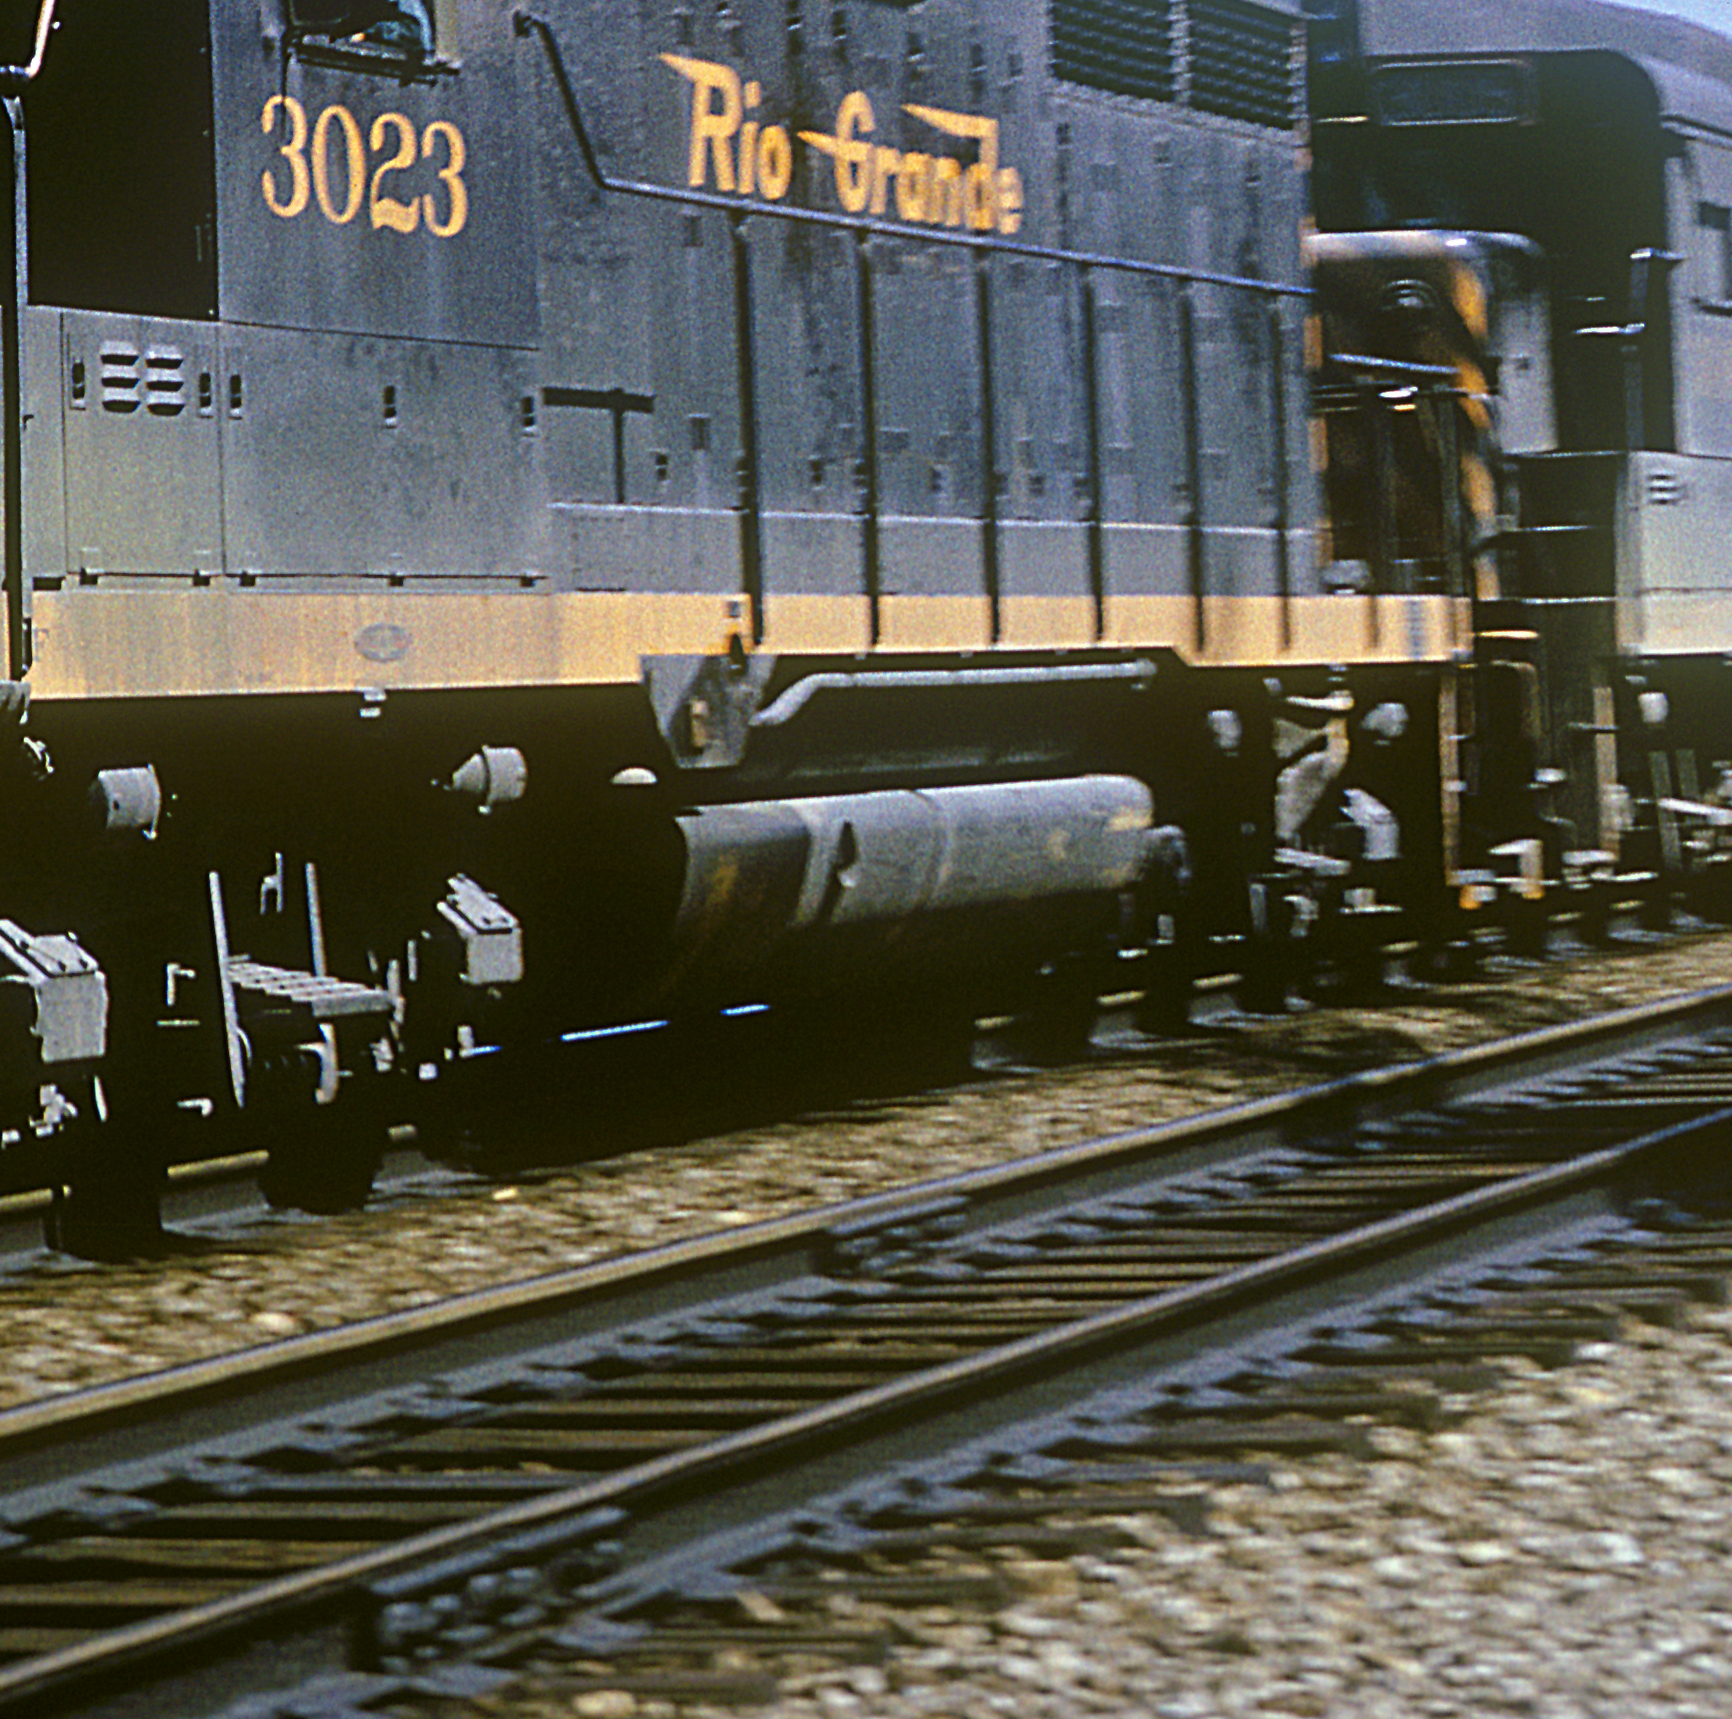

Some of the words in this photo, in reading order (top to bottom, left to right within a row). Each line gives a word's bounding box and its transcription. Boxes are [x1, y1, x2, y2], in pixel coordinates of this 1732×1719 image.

[261, 94, 468, 238] 3023
[659, 53, 792, 200] Rio
[797, 91, 1025, 235] Grande
